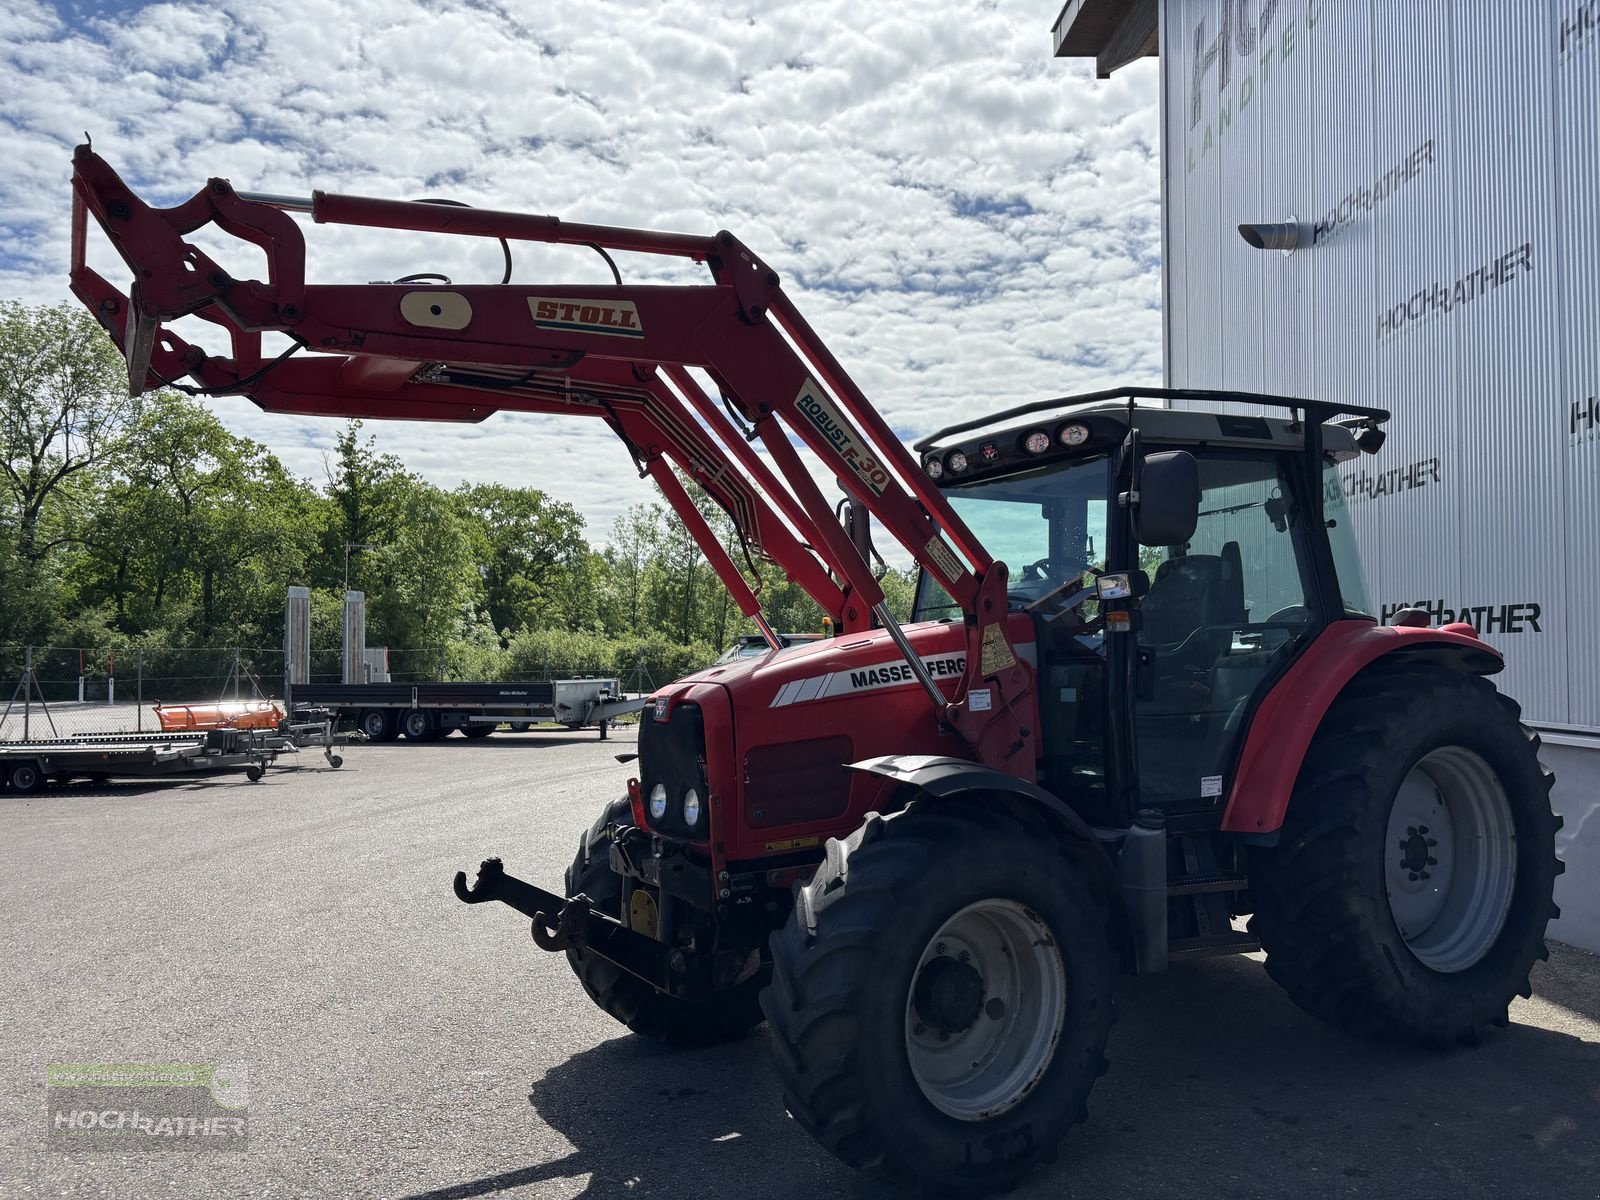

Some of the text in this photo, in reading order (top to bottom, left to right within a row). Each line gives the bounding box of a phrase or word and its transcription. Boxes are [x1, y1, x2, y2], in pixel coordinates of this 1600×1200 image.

[1313, 139, 1436, 245] HOCHRATHER
[1376, 242, 1534, 340] HOCHRATHER
[536, 301, 636, 328] STOLL
[800, 394, 851, 446] ROBUST
[1570, 397, 1600, 434] H
[1381, 599, 1542, 634] HHRATHER
[850, 658, 966, 688] MASSE FERG
